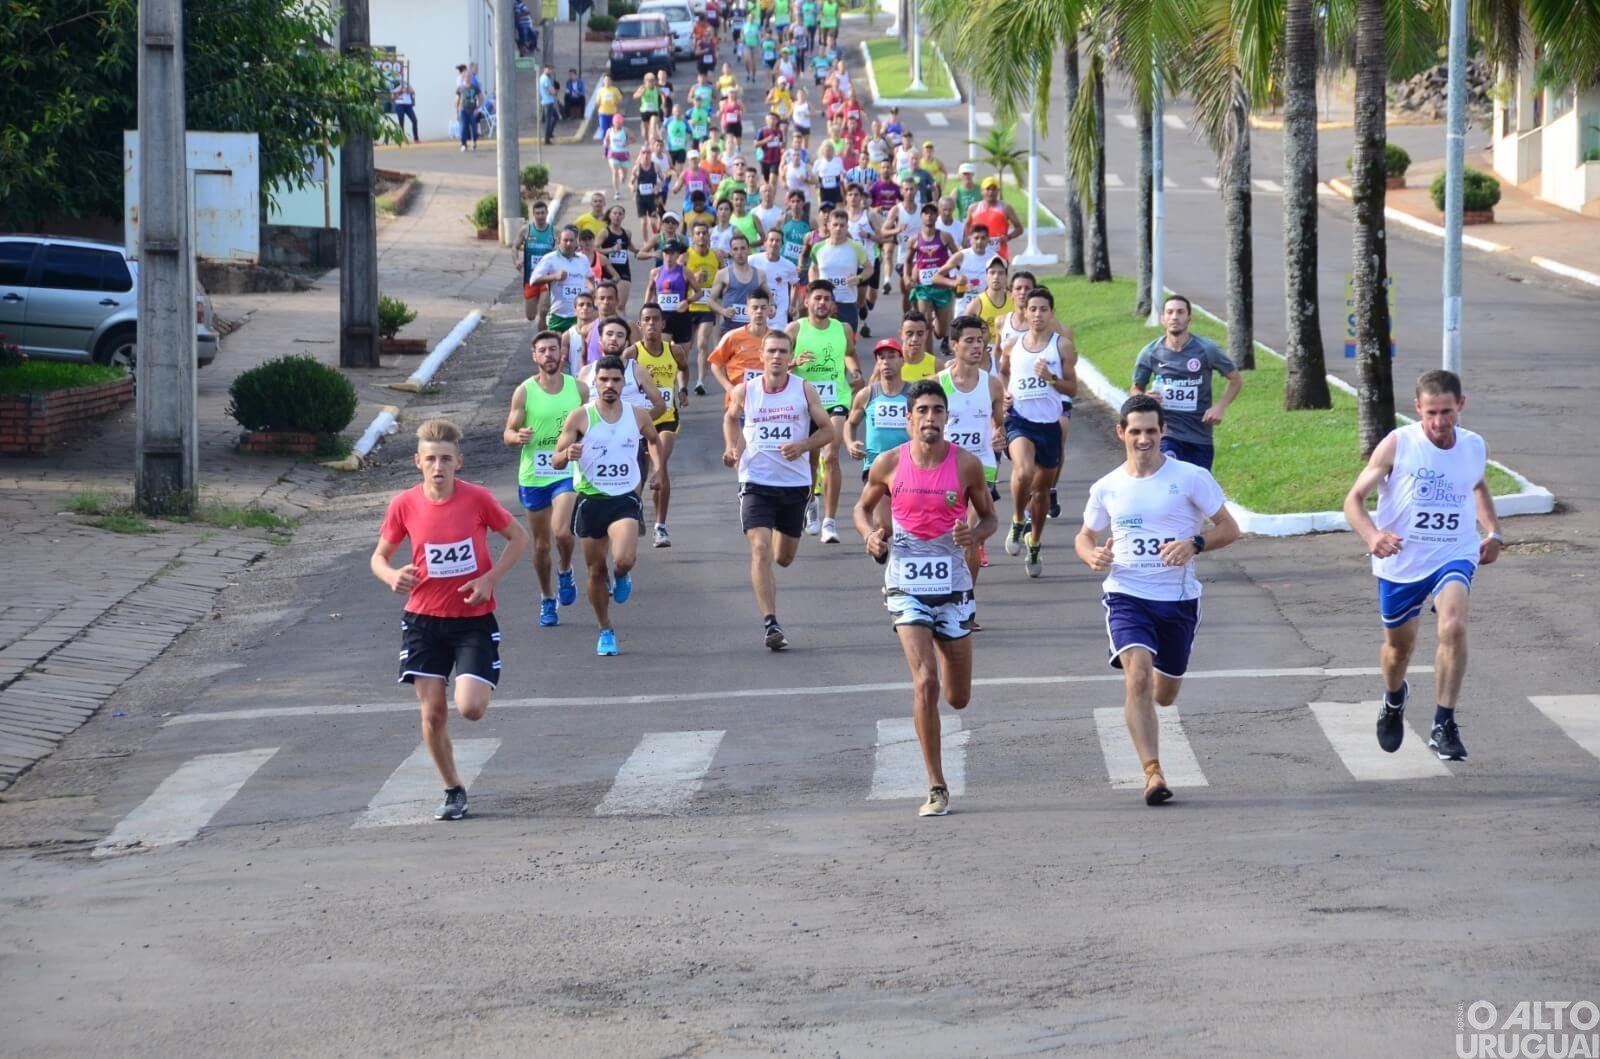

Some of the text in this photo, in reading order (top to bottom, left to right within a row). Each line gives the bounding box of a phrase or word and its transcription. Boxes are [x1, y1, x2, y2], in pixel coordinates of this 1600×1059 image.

[660, 296, 679, 304] 282
[813, 384, 834, 396] 71
[1018, 377, 1048, 390] 328
[1165, 389, 1195, 401] 384
[878, 405, 907, 417] 351
[759, 426, 792, 440] 344
[950, 431, 981, 446] 278
[596, 463, 629, 477] 239
[1437, 480, 1454, 491] Big
[1414, 511, 1460, 531] 235
[429, 544, 473, 564] 242
[904, 561, 949, 581] 348
